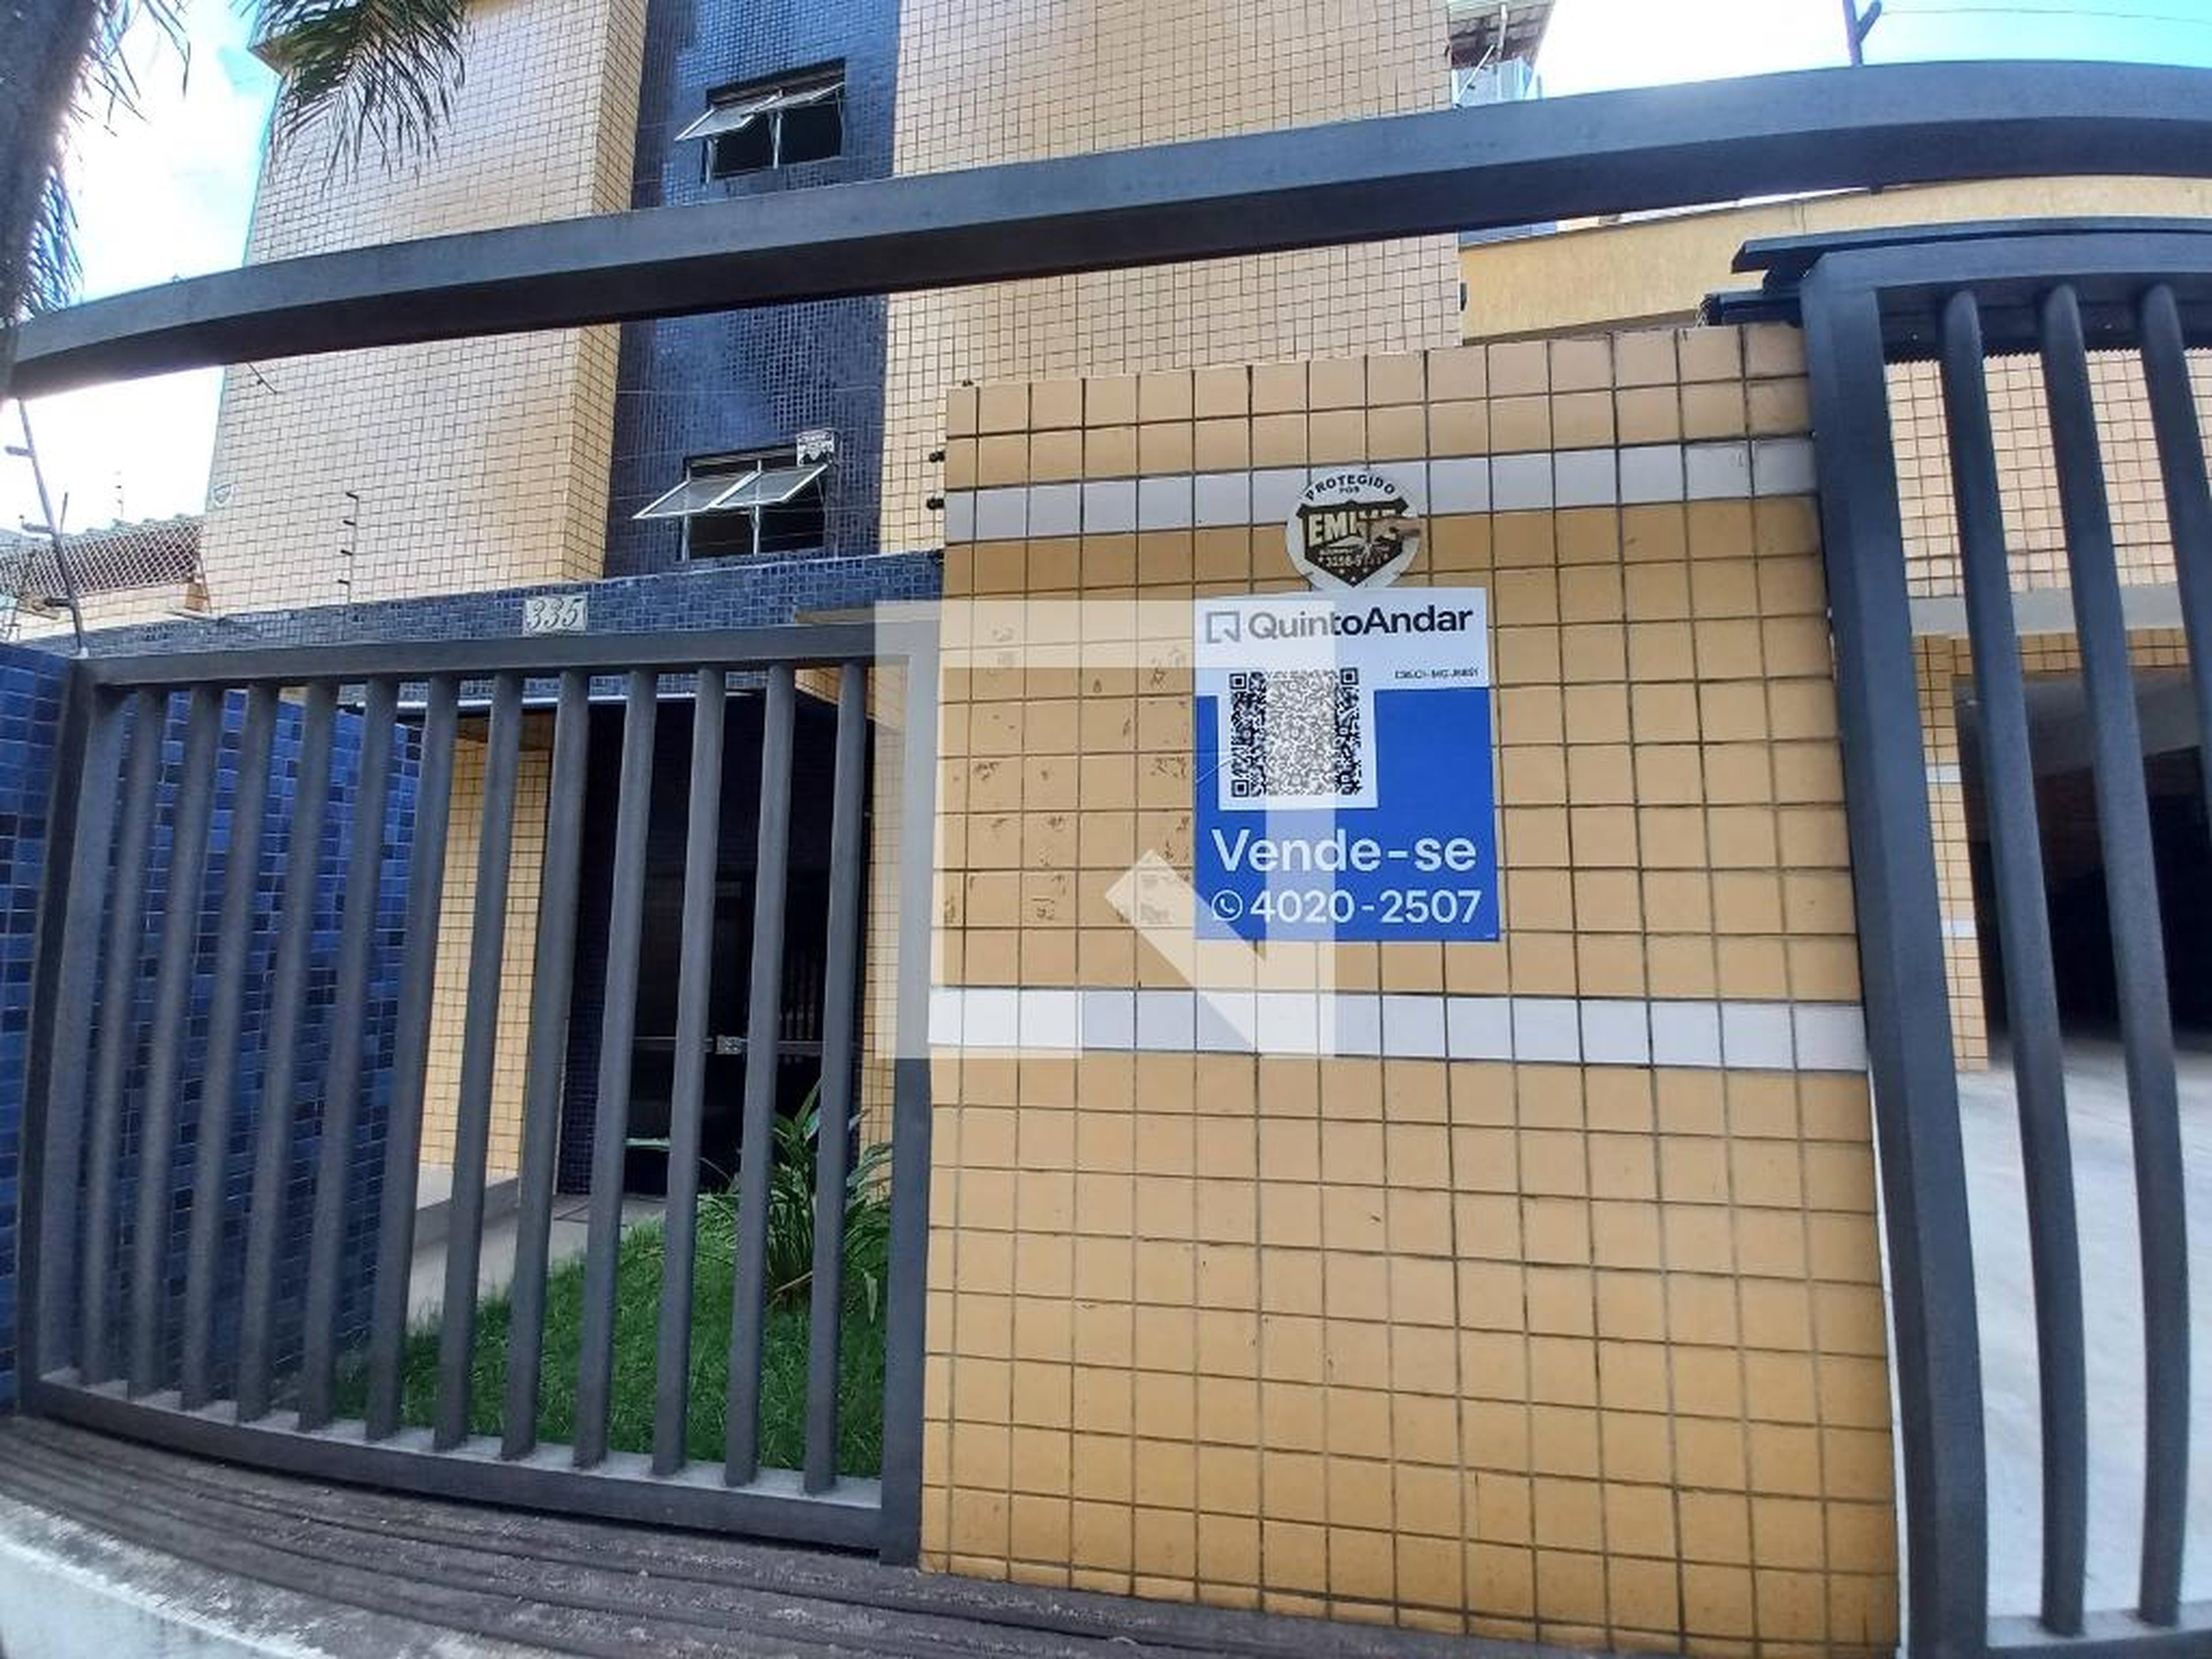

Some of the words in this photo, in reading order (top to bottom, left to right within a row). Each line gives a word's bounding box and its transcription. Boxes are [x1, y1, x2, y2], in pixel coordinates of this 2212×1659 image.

[1305, 474, 1395, 501] PROTEGIDO
[527, 597, 584, 629] 335
[1248, 605, 1474, 639] QuintoAndar
[1211, 828, 1477, 872] Vende-se
[1249, 889, 1483, 923] 4020-2507
